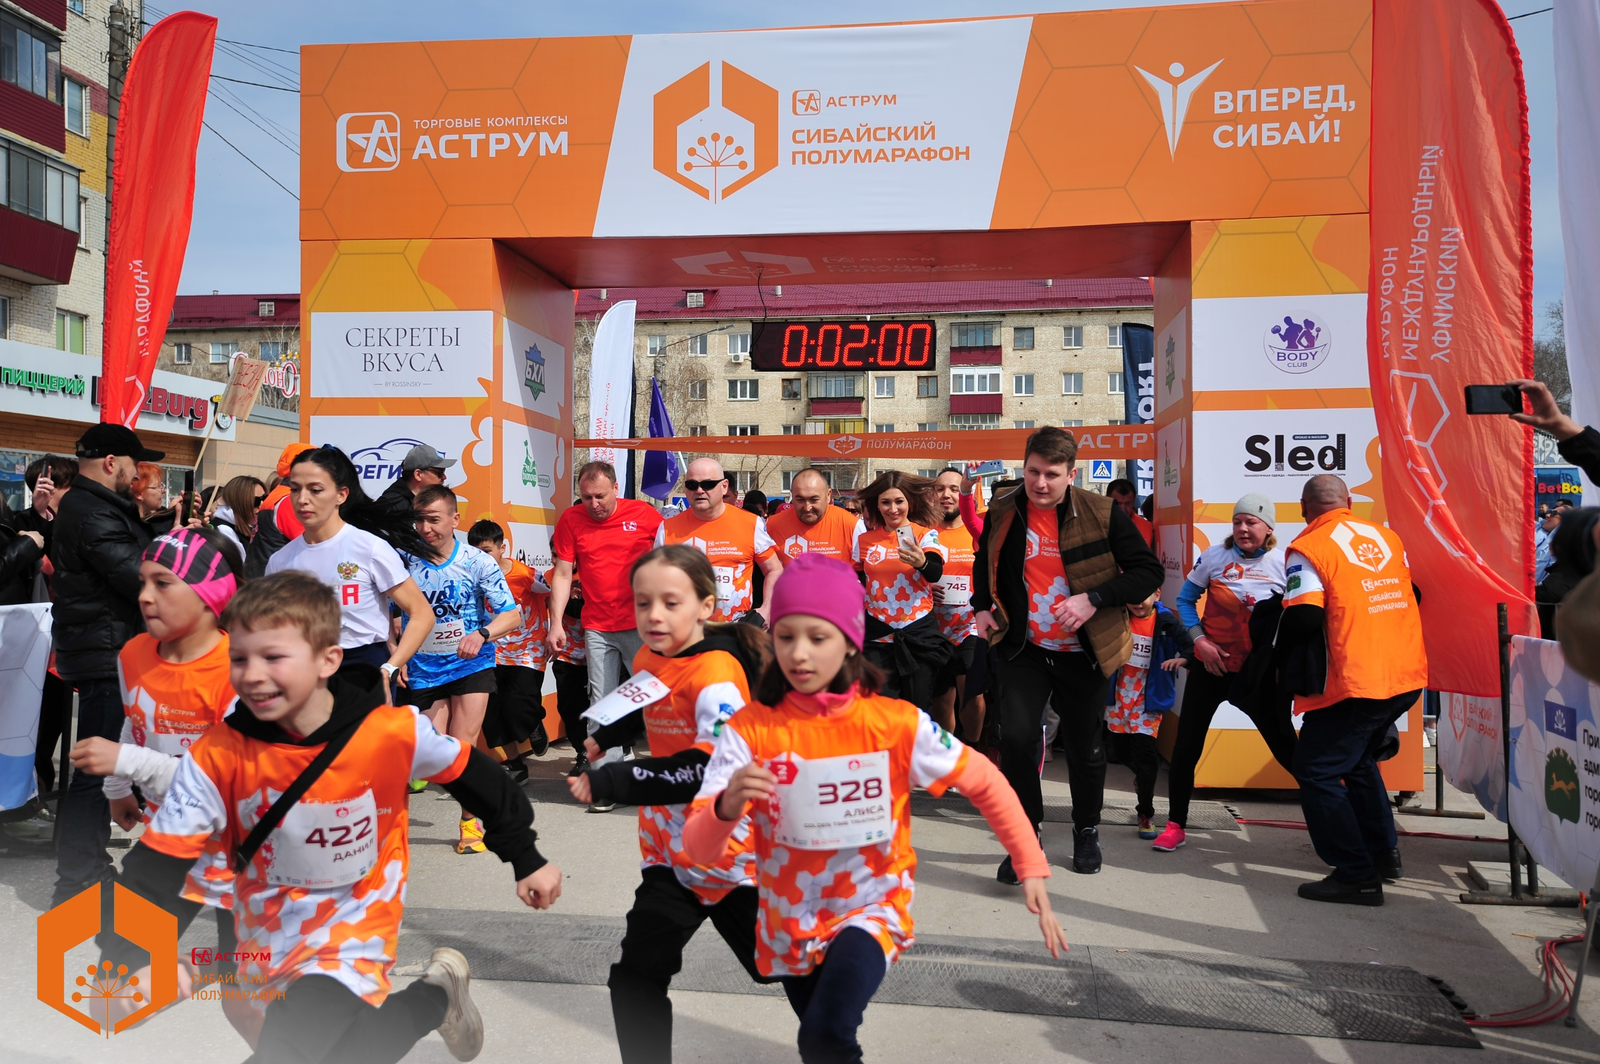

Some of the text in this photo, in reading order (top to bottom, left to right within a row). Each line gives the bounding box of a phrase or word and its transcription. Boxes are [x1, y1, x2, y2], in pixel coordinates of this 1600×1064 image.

[826, 94, 897, 107] АСТРУМ
[1214, 84, 1356, 114] ВПЕРЕД,
[413, 115, 568, 129] ТОРГОВЫЕ КОМПЛЕКСЫ
[1213, 113, 1341, 148] СИБАЙ!
[792, 121, 936, 144] СИБАЙСКИЙ
[411, 131, 569, 160] АСТРУМ
[792, 146, 970, 166] ПОЛУМАРАФОН
[345, 327, 461, 348] СЕКРЕТЫ
[781, 323, 932, 367] 0:02:00
[362, 352, 445, 373] ВКУСА
[1276, 351, 1318, 361] BODY
[2, 367, 86, 395] ПИЦЦЕРИЙ
[866, 439, 952, 450] ПОЛУМАРАФОН
[1244, 433, 1346, 472] Sled
[356, 464, 403, 480] РЕГИ
[715, 575, 730, 583] 49
[946, 583, 967, 591] 745
[1374, 577, 1400, 587] АСТРУМ
[1368, 590, 1403, 603] СИБАЙСКИЙ
[1367, 601, 1409, 614] ПОЛУМАРАФОН
[434, 628, 462, 640] 226
[617, 682, 651, 704] 836
[1583, 728, 1600, 751] При
[1583, 759, 1600, 777] адм
[818, 777, 883, 805] 328
[843, 805, 885, 818] АЛИСА
[305, 815, 373, 848] 422
[333, 837, 374, 863] ДАНИЛ
